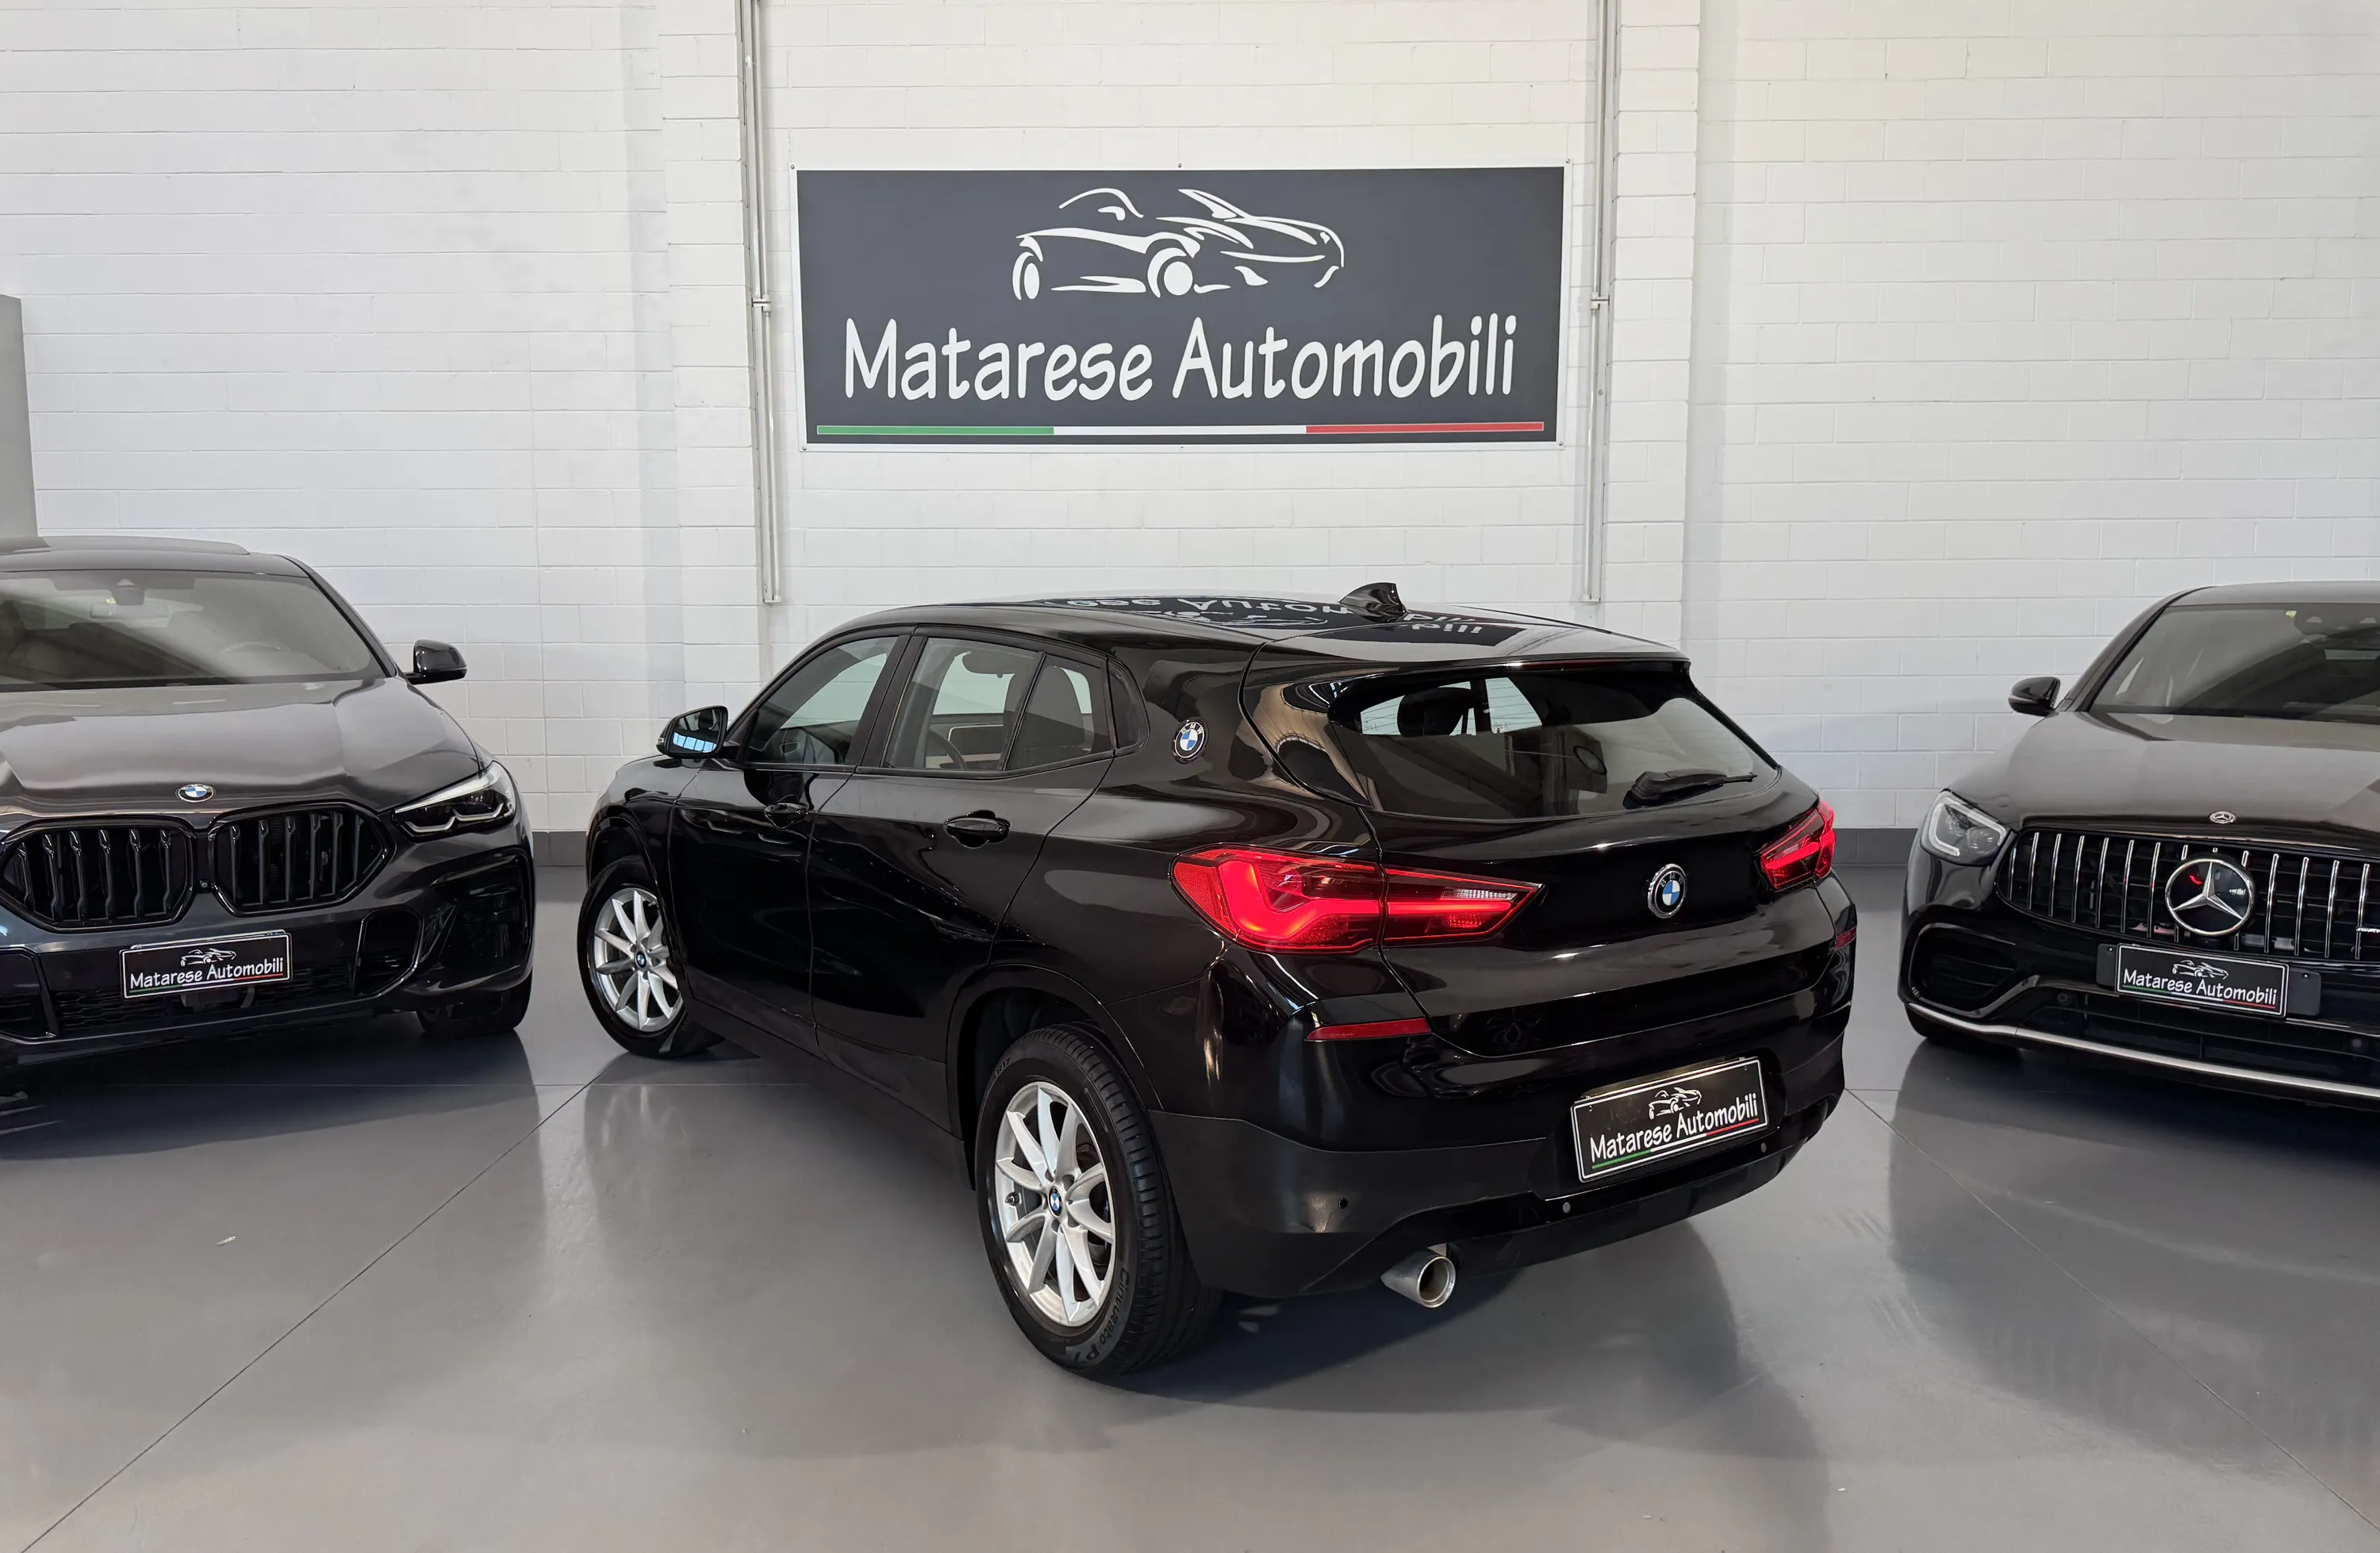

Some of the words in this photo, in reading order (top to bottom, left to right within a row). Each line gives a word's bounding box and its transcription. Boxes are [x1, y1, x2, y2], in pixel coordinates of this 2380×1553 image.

[844, 317, 1153, 401] Matarese
[1172, 313, 1517, 401] Automobili
[1660, 872, 1684, 888] BMW
[129, 969, 203, 989] Matarese
[206, 957, 284, 981] Automobili
[2123, 968, 2193, 993] Matarese
[2196, 978, 2278, 1006] Automobili
[1590, 1123, 1673, 1163] Matarese
[1676, 1092, 1759, 1139] Automobili
